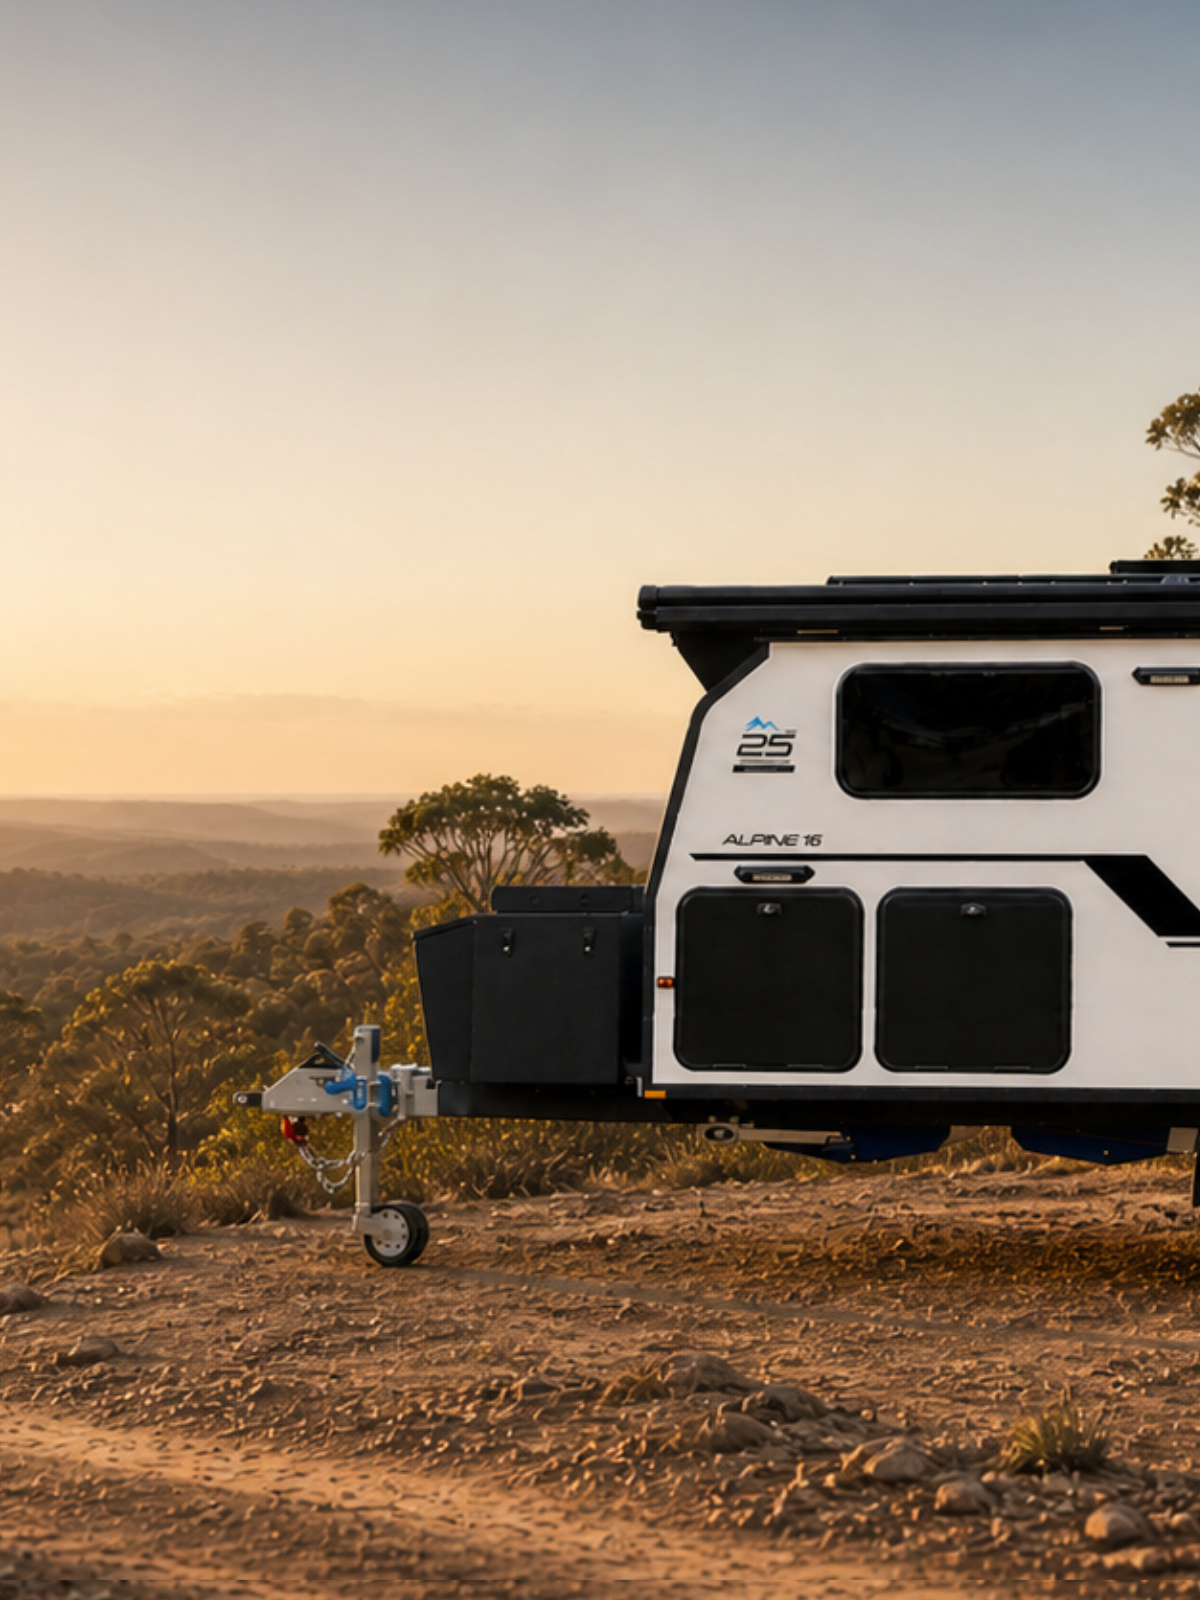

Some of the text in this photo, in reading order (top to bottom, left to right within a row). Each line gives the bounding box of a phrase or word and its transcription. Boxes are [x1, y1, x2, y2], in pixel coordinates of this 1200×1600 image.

[736, 734, 796, 757] 25
[722, 833, 823, 847] ALPINE 16
